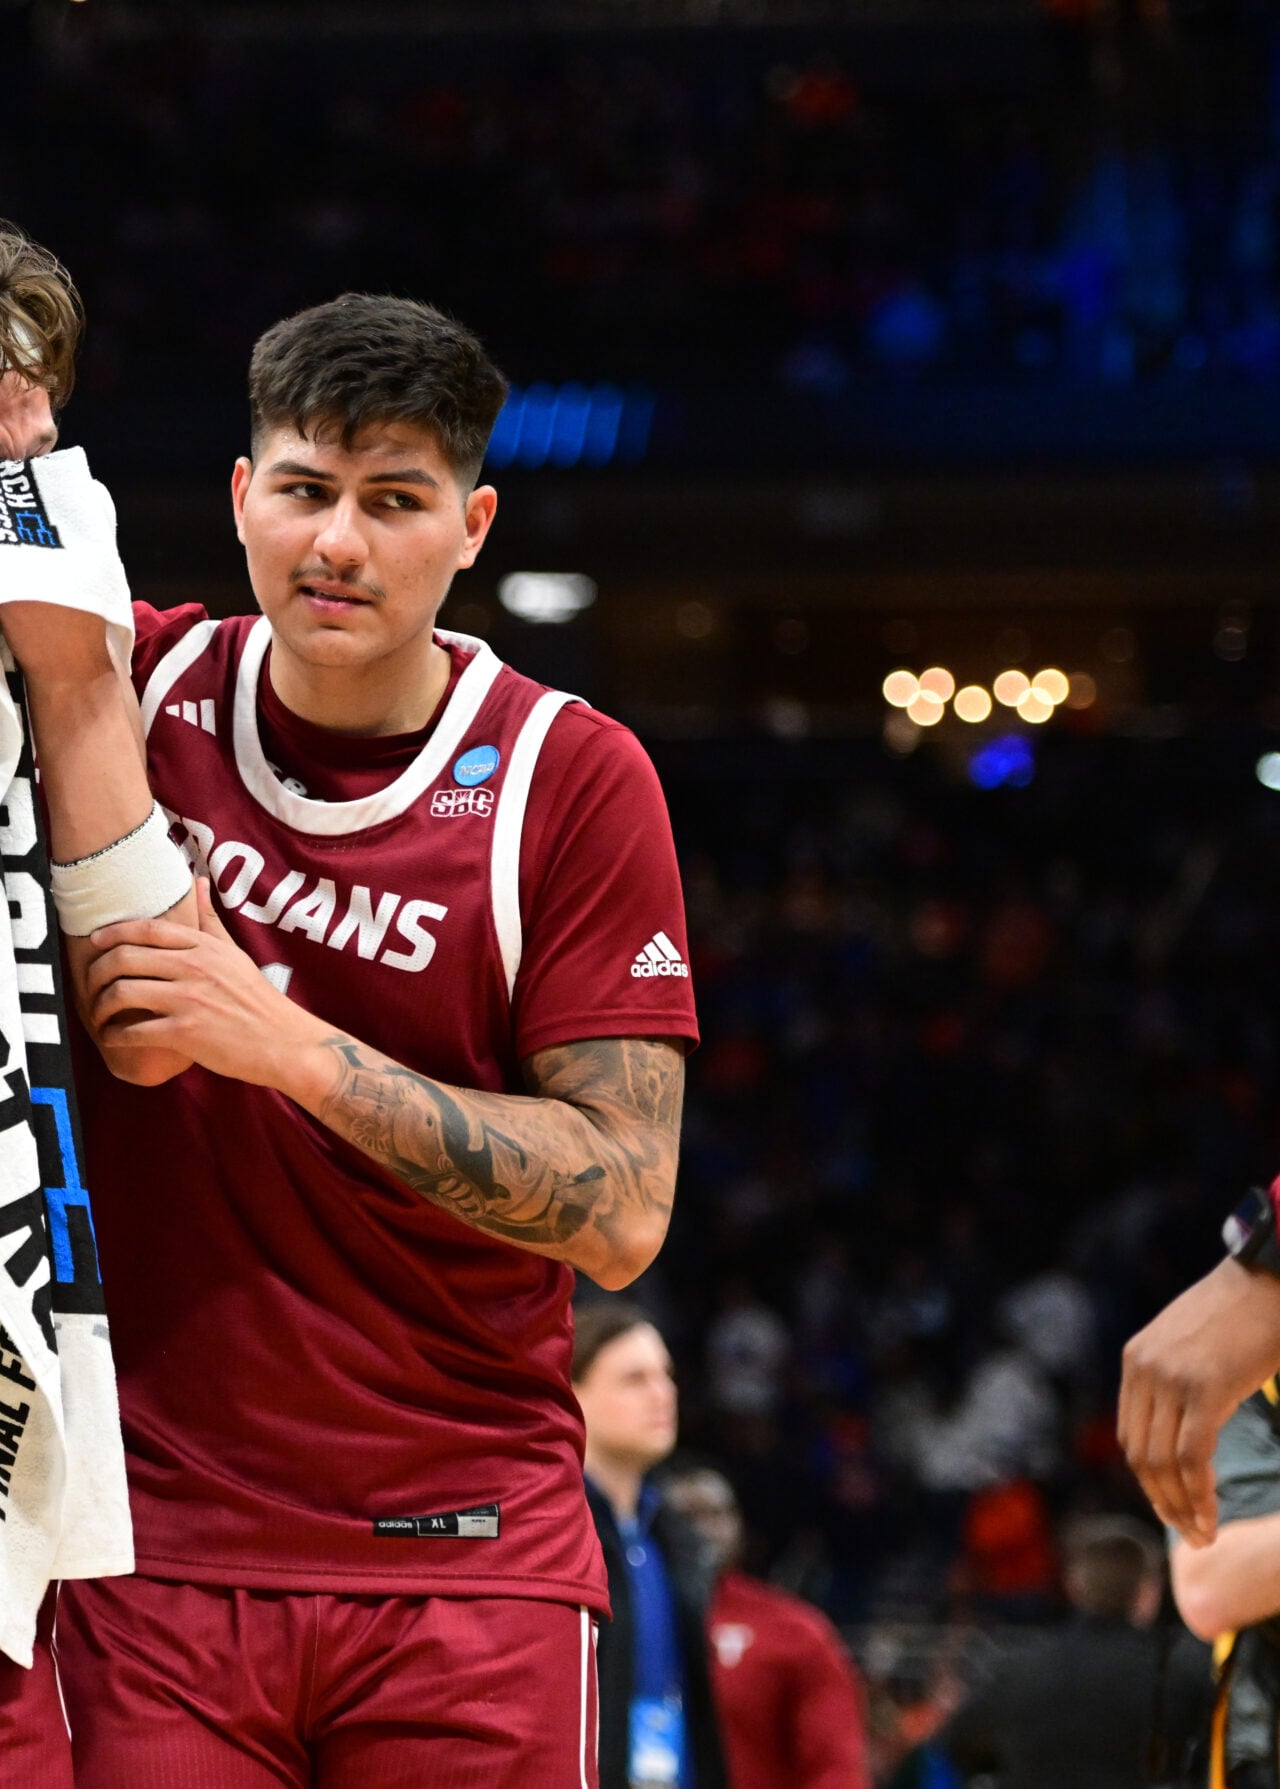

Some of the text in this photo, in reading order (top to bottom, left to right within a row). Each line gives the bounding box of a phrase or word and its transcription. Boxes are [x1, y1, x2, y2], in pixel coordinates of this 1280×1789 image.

[430, 787, 495, 818] SBC
[630, 960, 689, 978] adidas
[378, 1518, 447, 1529] adidas XL
